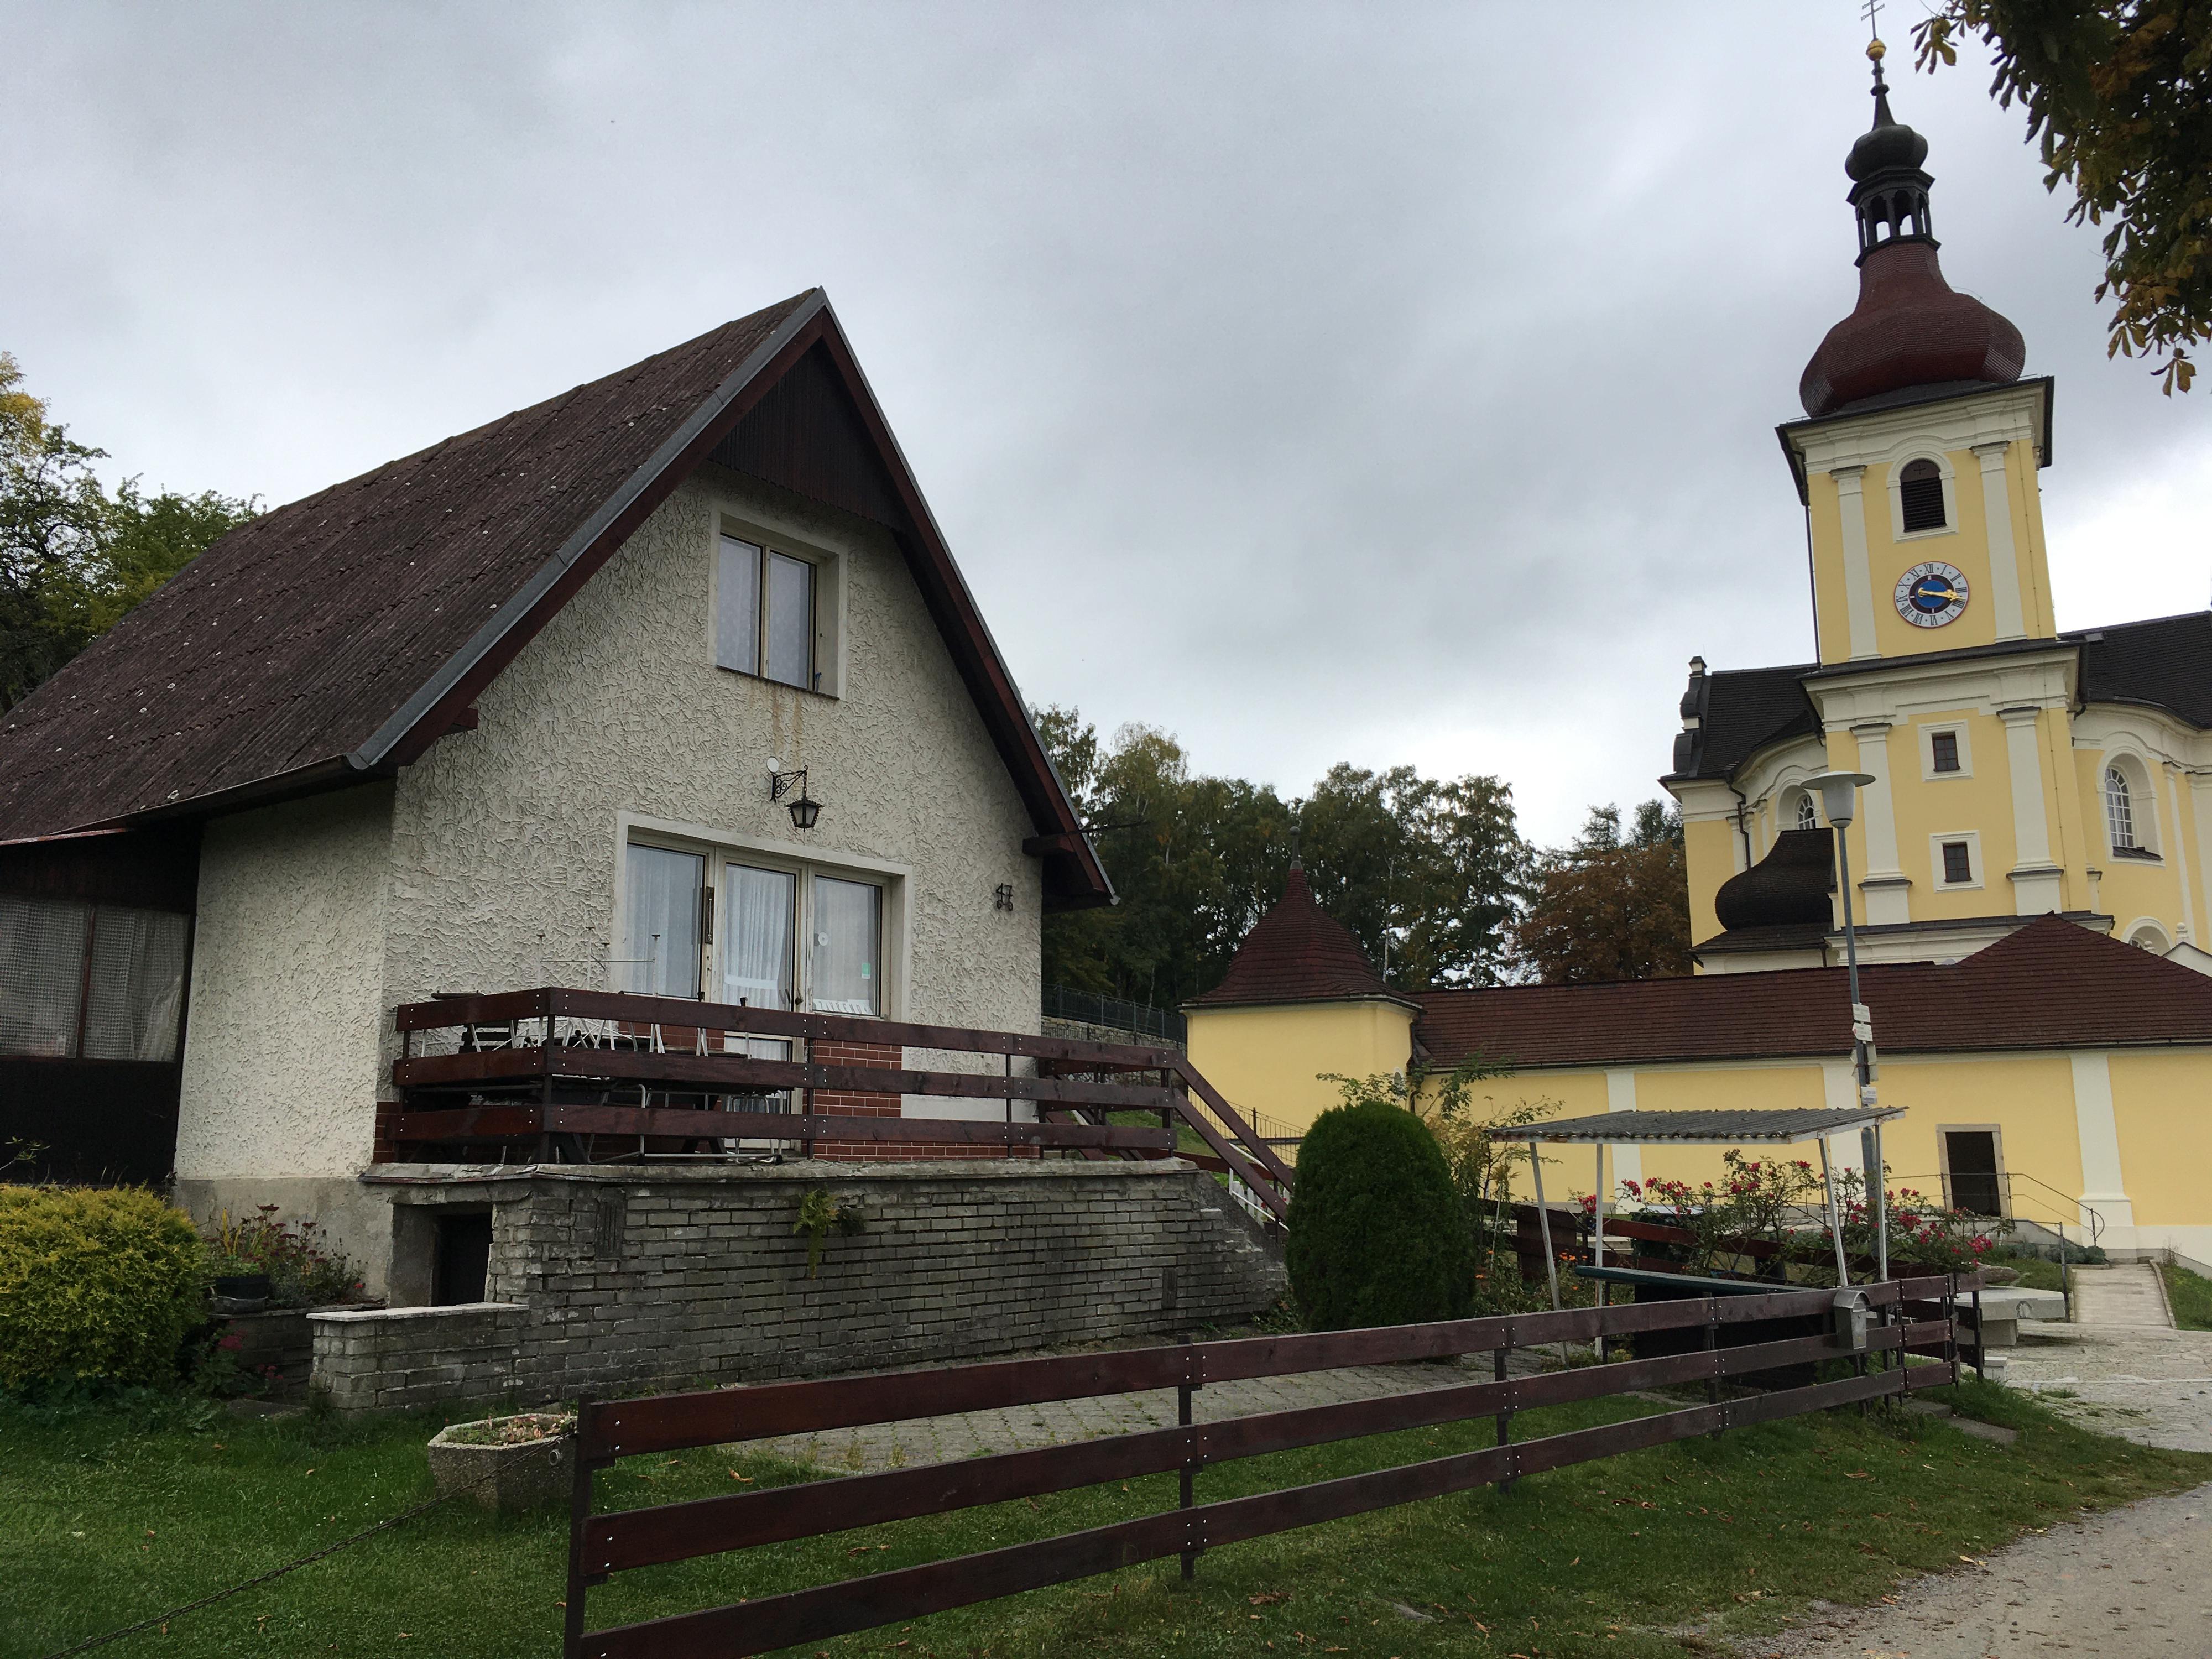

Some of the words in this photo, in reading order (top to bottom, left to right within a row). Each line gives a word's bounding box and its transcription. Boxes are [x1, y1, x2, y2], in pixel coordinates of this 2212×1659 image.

[1908, 568, 1921, 580] XI
[1923, 563, 1934, 575] XII
[1940, 565, 1948, 575] I
[1950, 573, 1962, 582] II
[1898, 581, 1911, 589] X
[1896, 594, 1908, 603] IX
[1900, 604, 1914, 618] VIII
[1944, 611, 1954, 620] V
[1912, 612, 1924, 625] VII
[1929, 615, 1938, 626] VI
[995, 883, 1013, 911] 47
